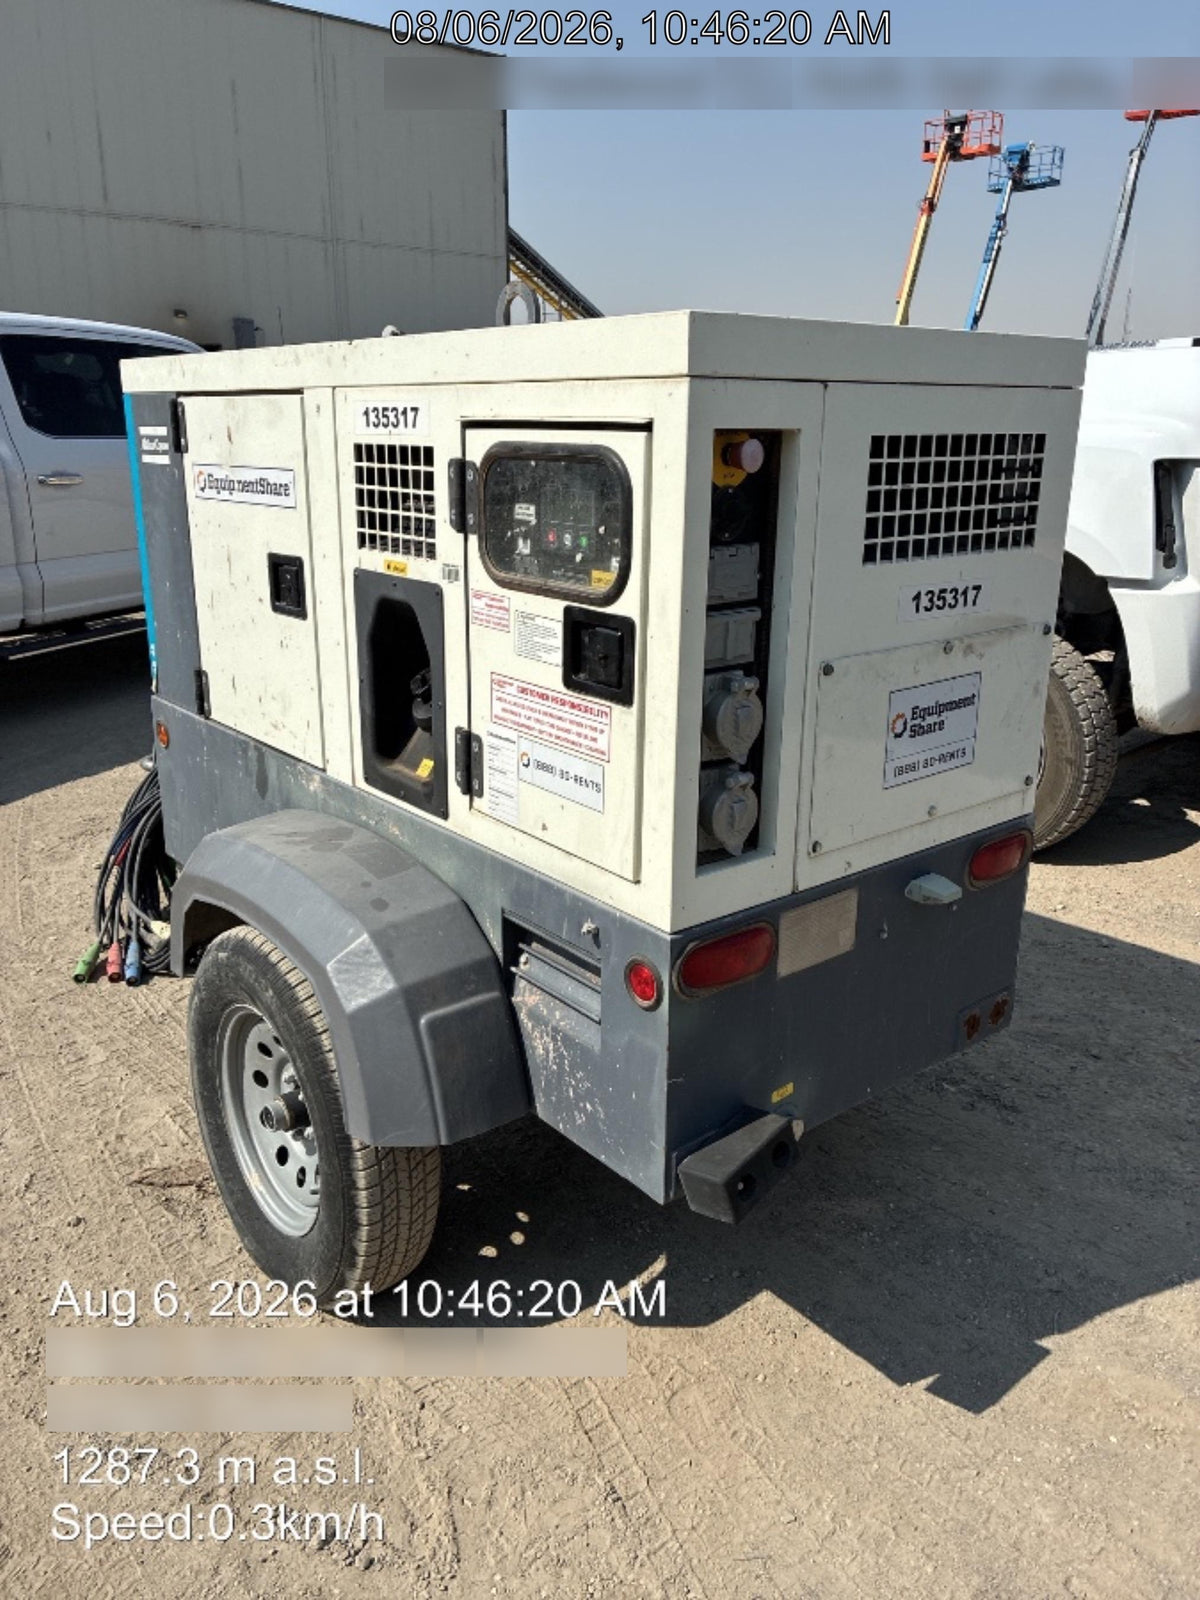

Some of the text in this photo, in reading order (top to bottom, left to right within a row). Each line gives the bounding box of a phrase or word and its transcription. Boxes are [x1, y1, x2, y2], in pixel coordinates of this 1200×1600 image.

[363, 406, 420, 429] 135317
[207, 472, 291, 497] EquipmentShare
[911, 585, 982, 614] 135317
[910, 692, 977, 722] Equipment
[908, 719, 946, 739] Share
